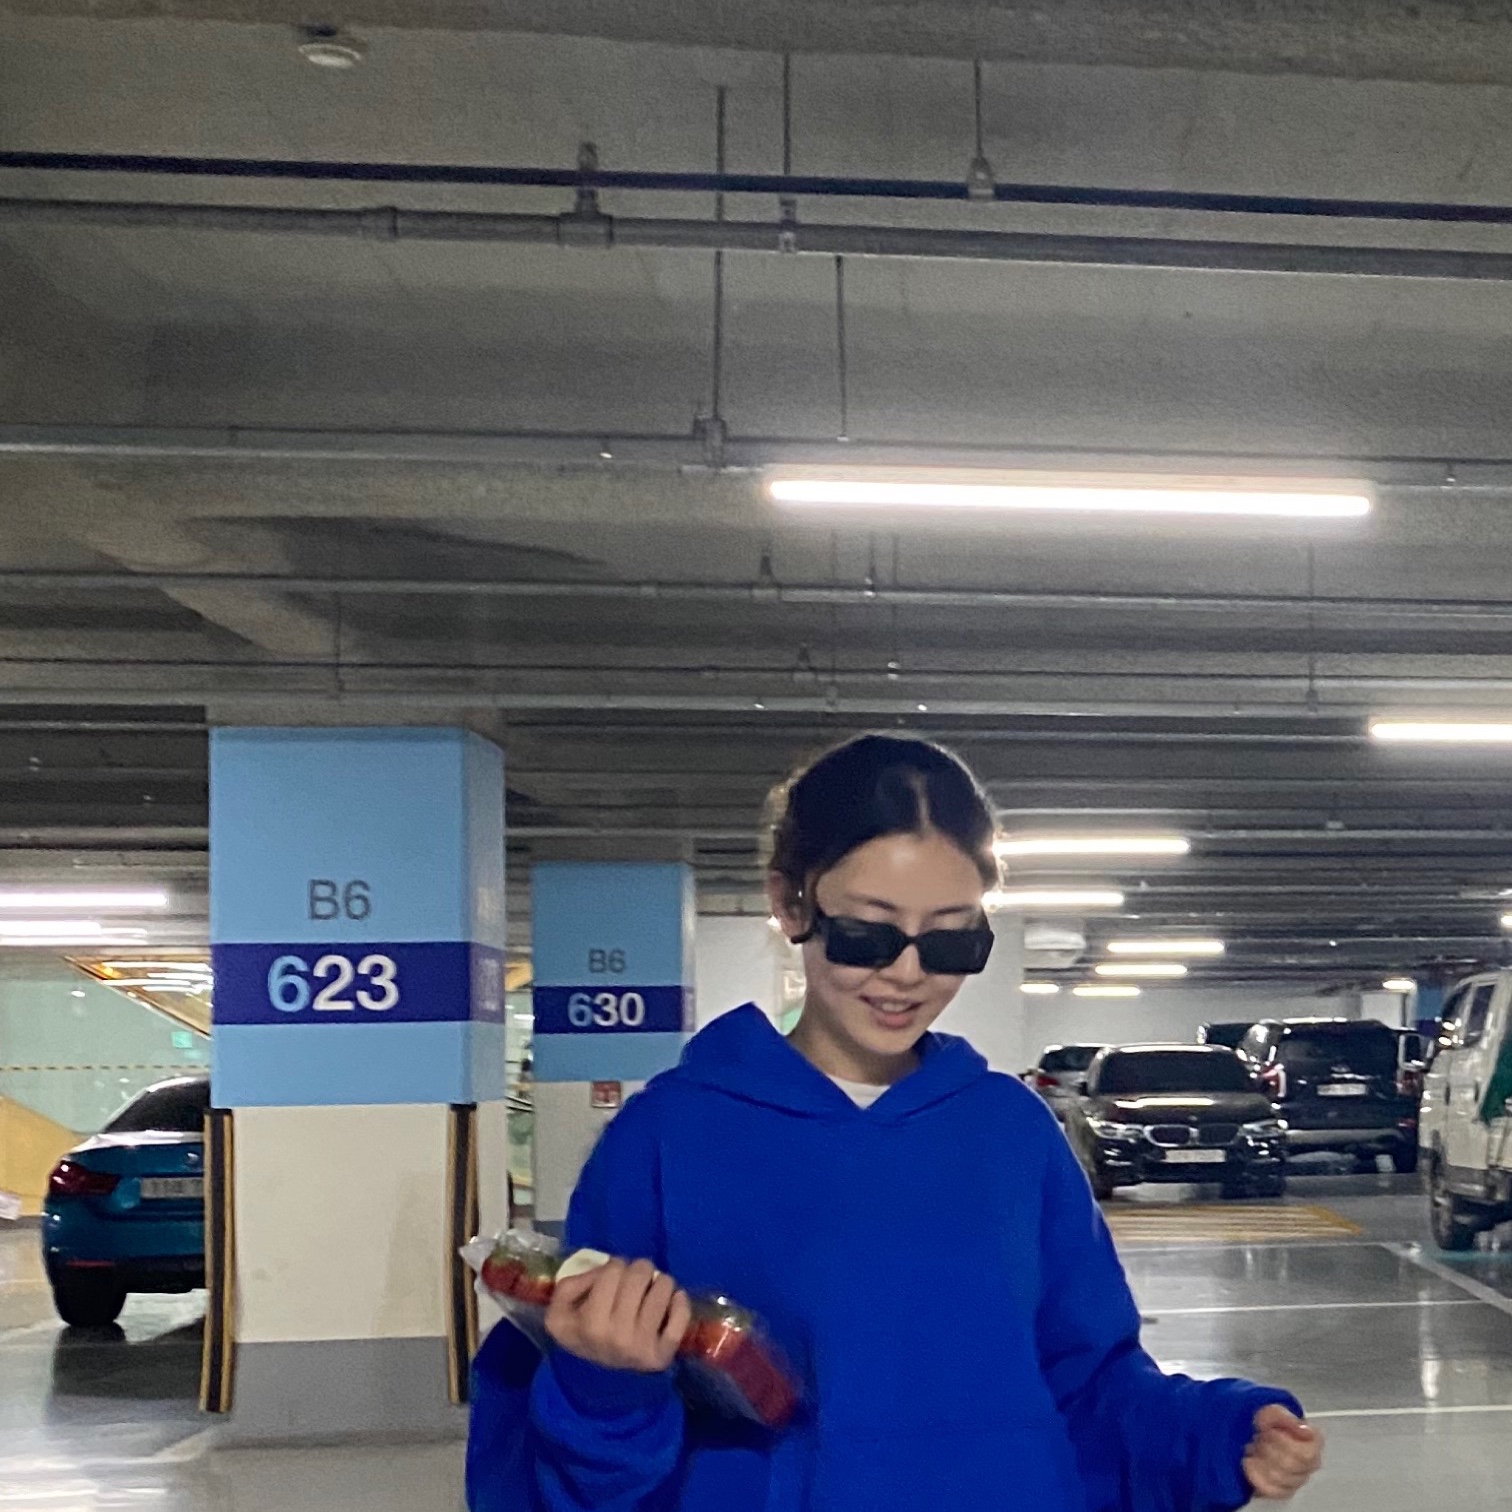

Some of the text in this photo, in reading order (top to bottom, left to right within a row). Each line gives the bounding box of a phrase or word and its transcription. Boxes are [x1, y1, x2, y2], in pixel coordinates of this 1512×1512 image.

[307, 878, 372, 921] B6
[588, 949, 626, 974] B6
[267, 953, 399, 1013] 623
[567, 992, 646, 1027] 630
